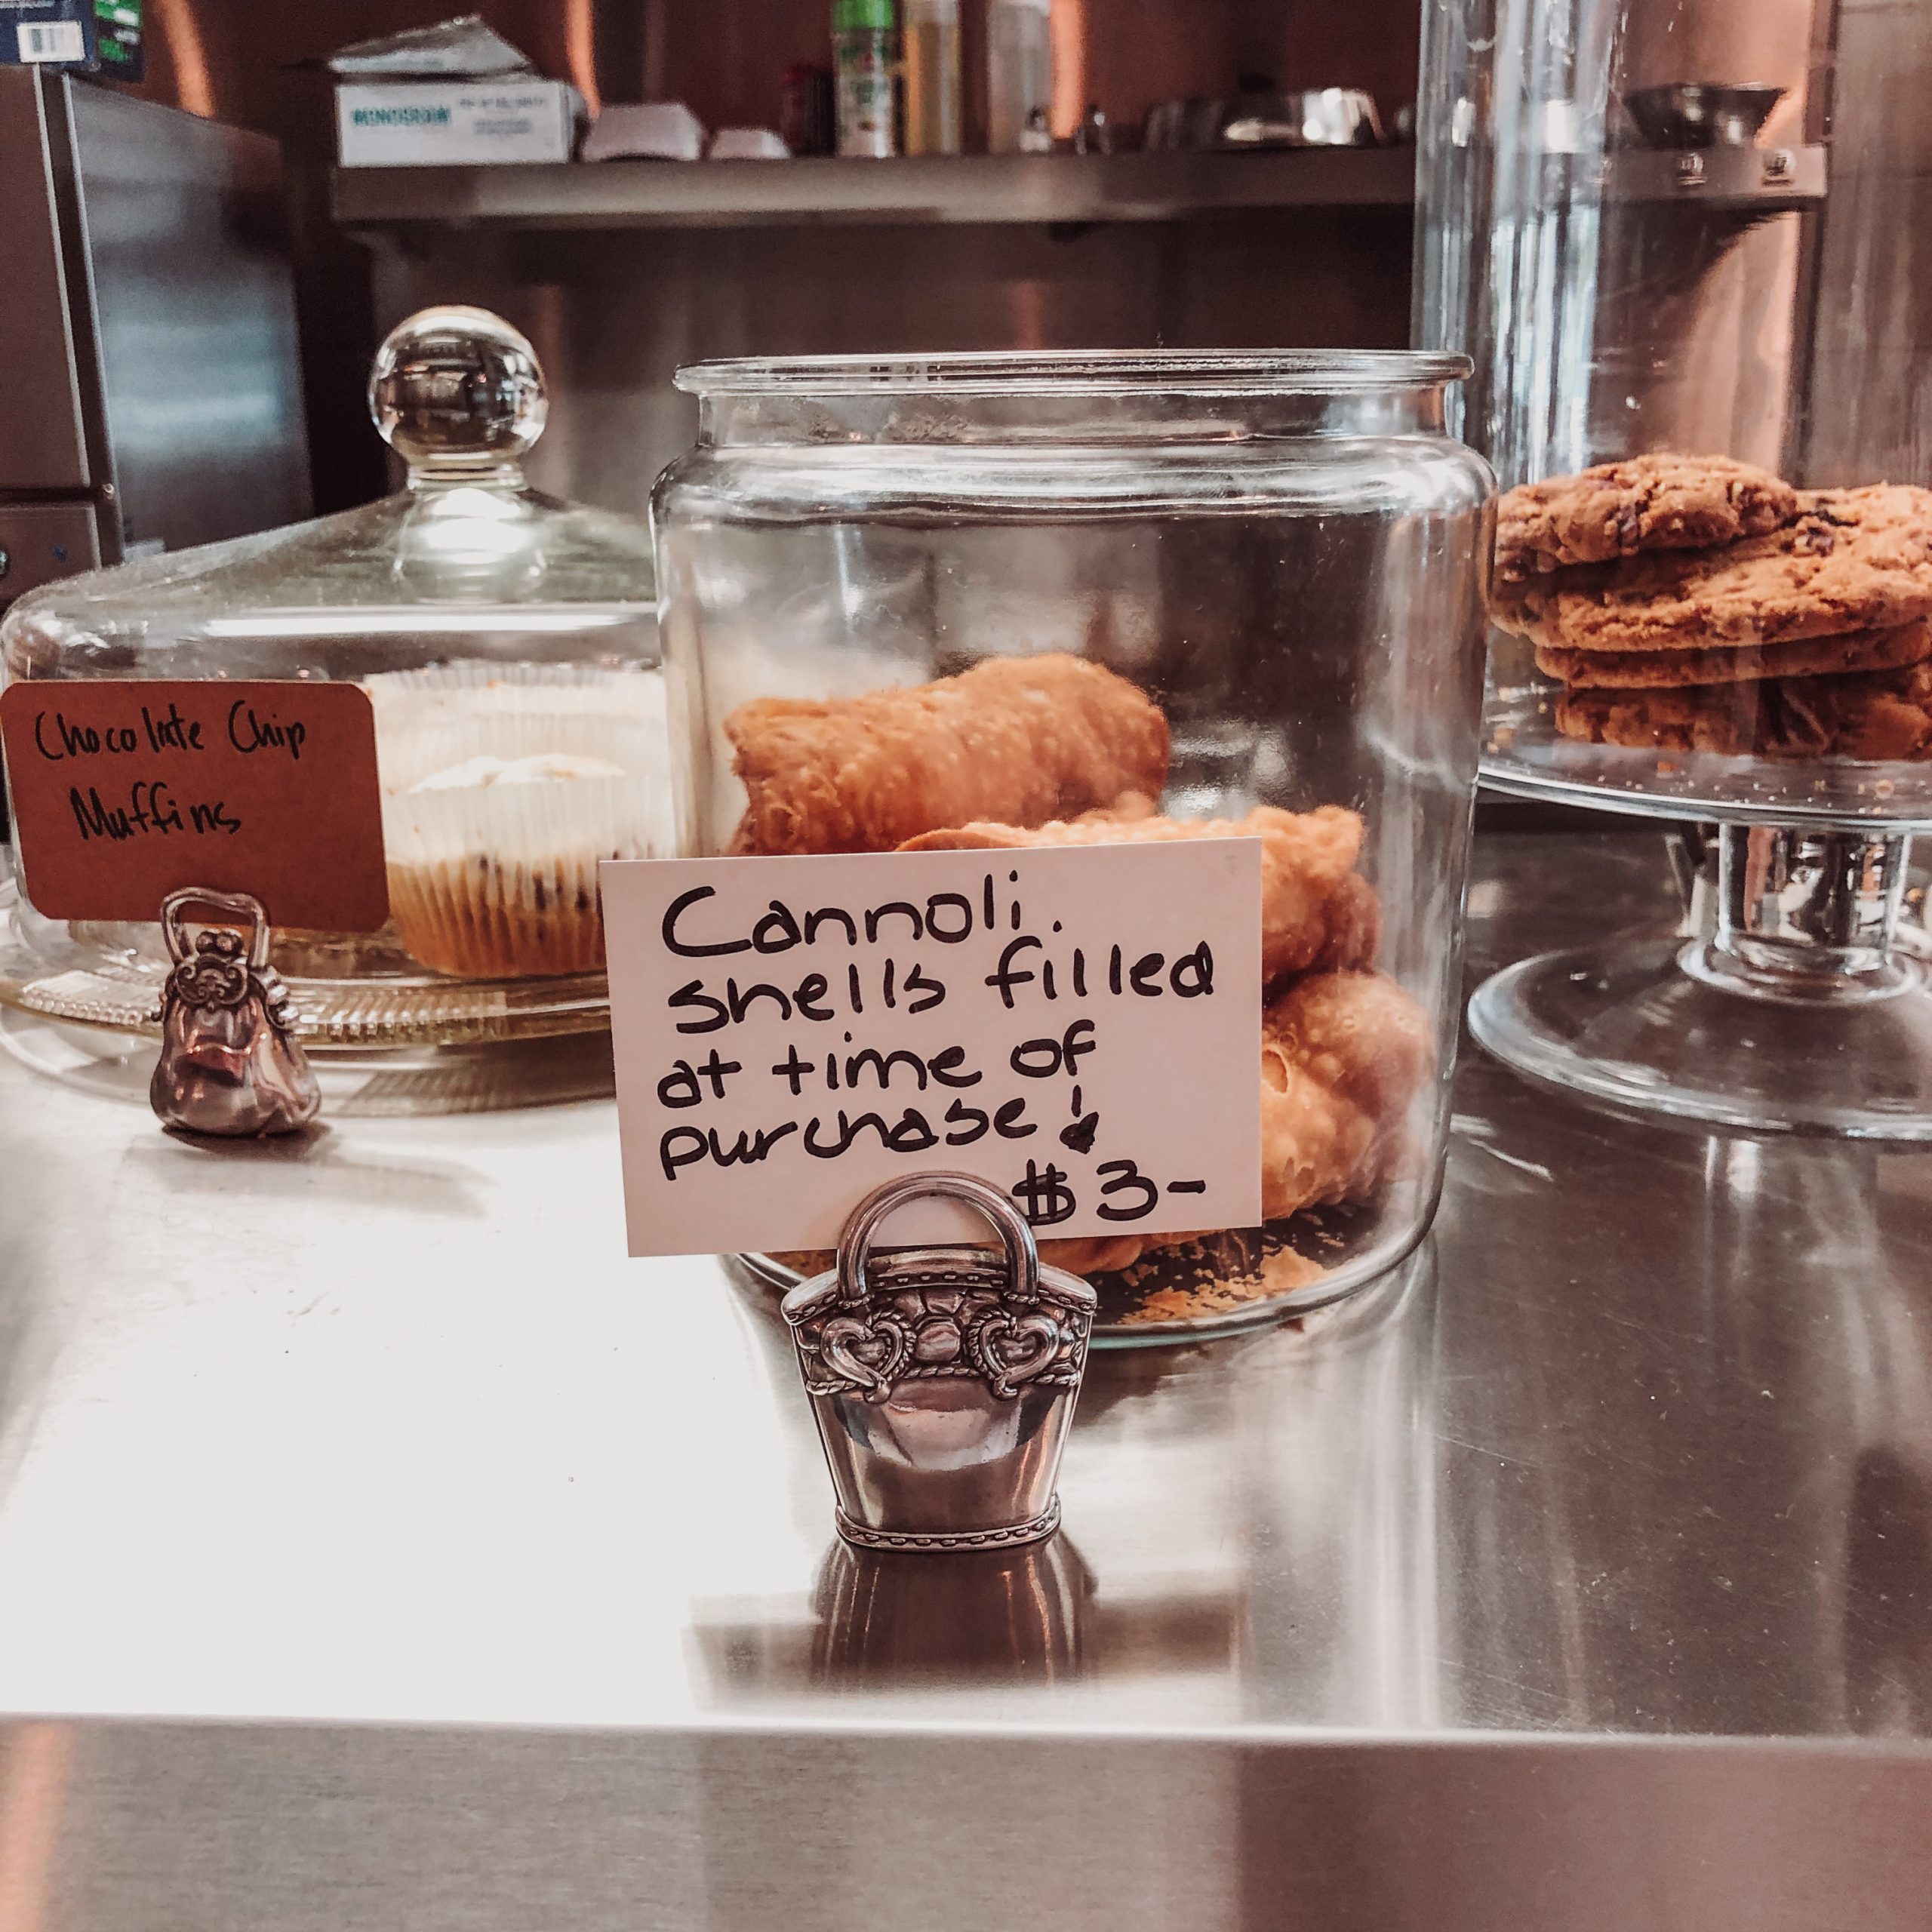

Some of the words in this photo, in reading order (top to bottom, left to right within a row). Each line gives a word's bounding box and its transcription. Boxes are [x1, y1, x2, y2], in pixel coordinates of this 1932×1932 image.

[35, 703, 205, 760] Chocolate
[229, 700, 306, 761] Chip
[69, 781, 242, 841] Muffins
[668, 958, 946, 1035] shells
[984, 936, 1214, 1010] filled
[657, 1048, 743, 1109] at
[771, 1031, 983, 1096] time
[1010, 1019, 1097, 1078] of
